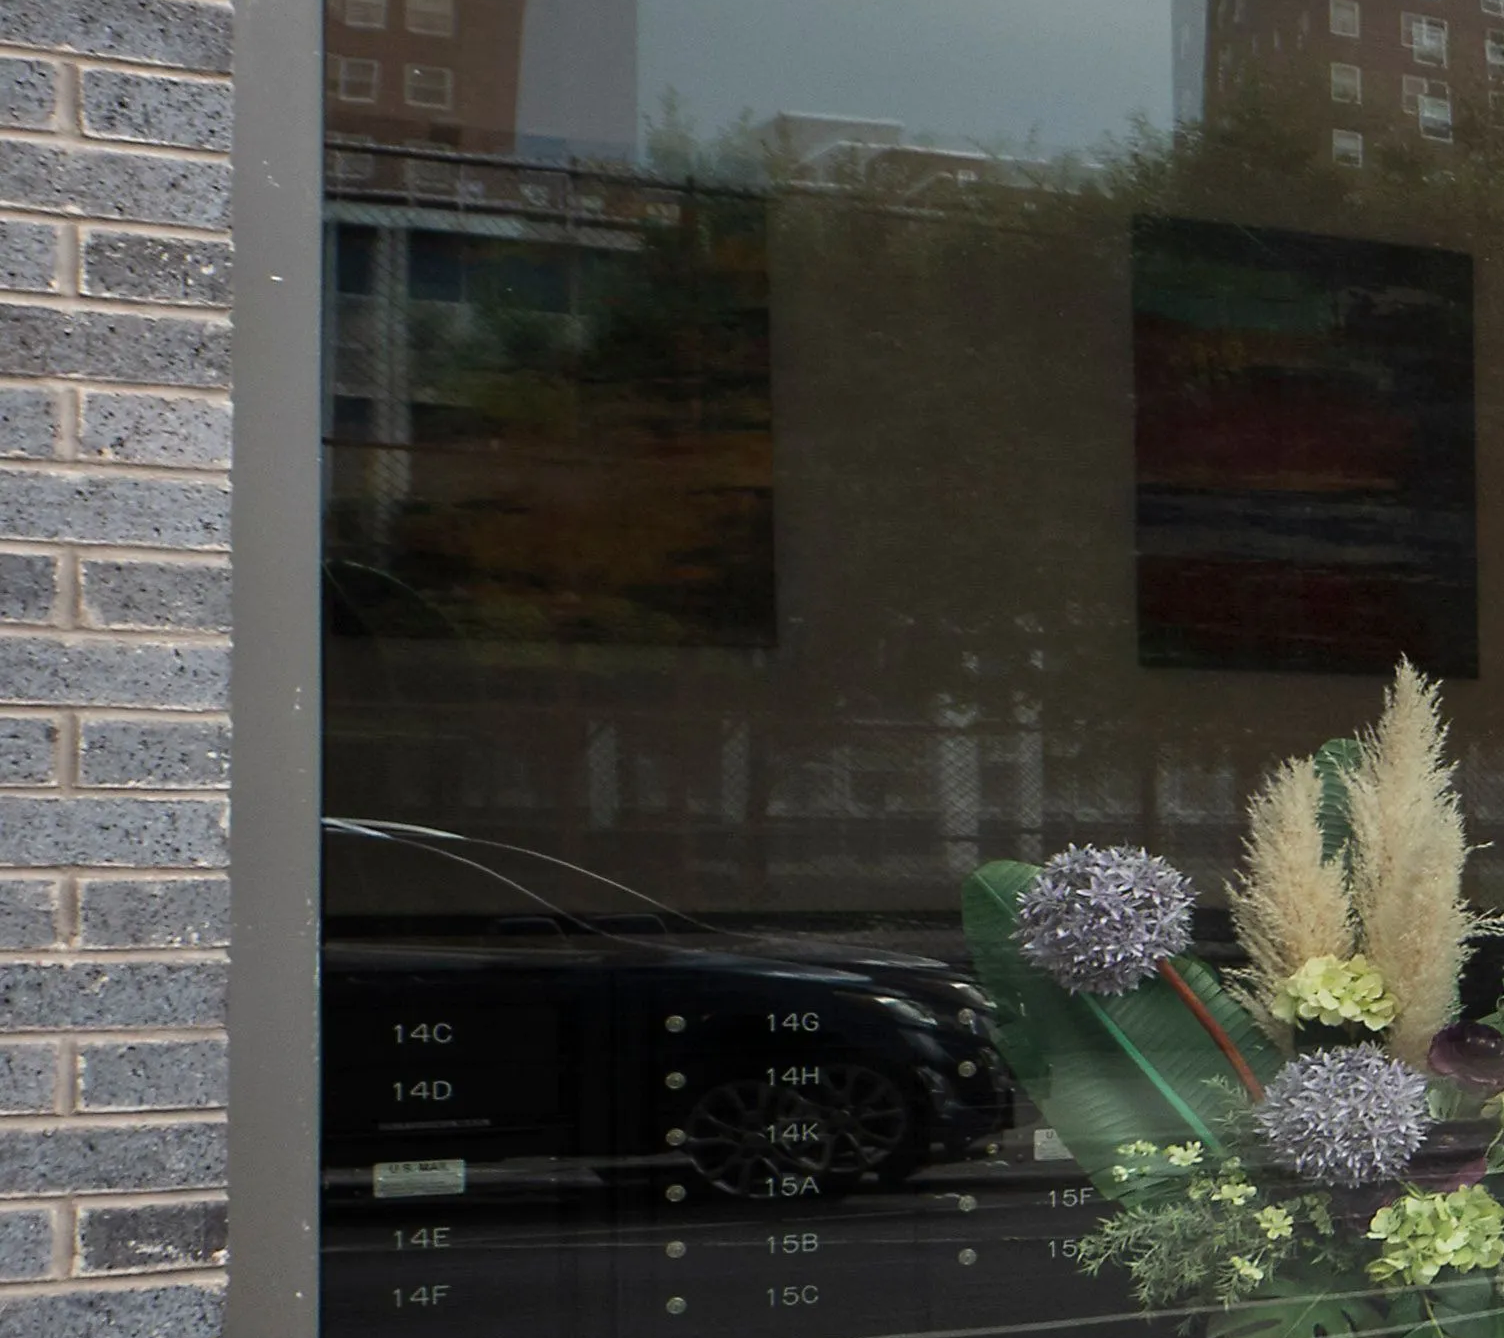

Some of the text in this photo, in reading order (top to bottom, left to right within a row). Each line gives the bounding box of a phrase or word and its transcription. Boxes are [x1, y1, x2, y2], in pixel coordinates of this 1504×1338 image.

[394, 1022, 453, 1044] 14C
[767, 1012, 820, 1032] 14G
[767, 1066, 820, 1086] 14H
[393, 1080, 453, 1102] 14D
[767, 1122, 819, 1143] 14K
[766, 1175, 820, 1197] 15A
[1048, 1187, 1094, 1208] 15F
[394, 1227, 451, 1250] 14E
[767, 1232, 819, 1254] 15B
[1048, 1238, 1079, 1258] 15
[394, 1284, 451, 1308] 14F
[767, 1284, 819, 1306] 15C
